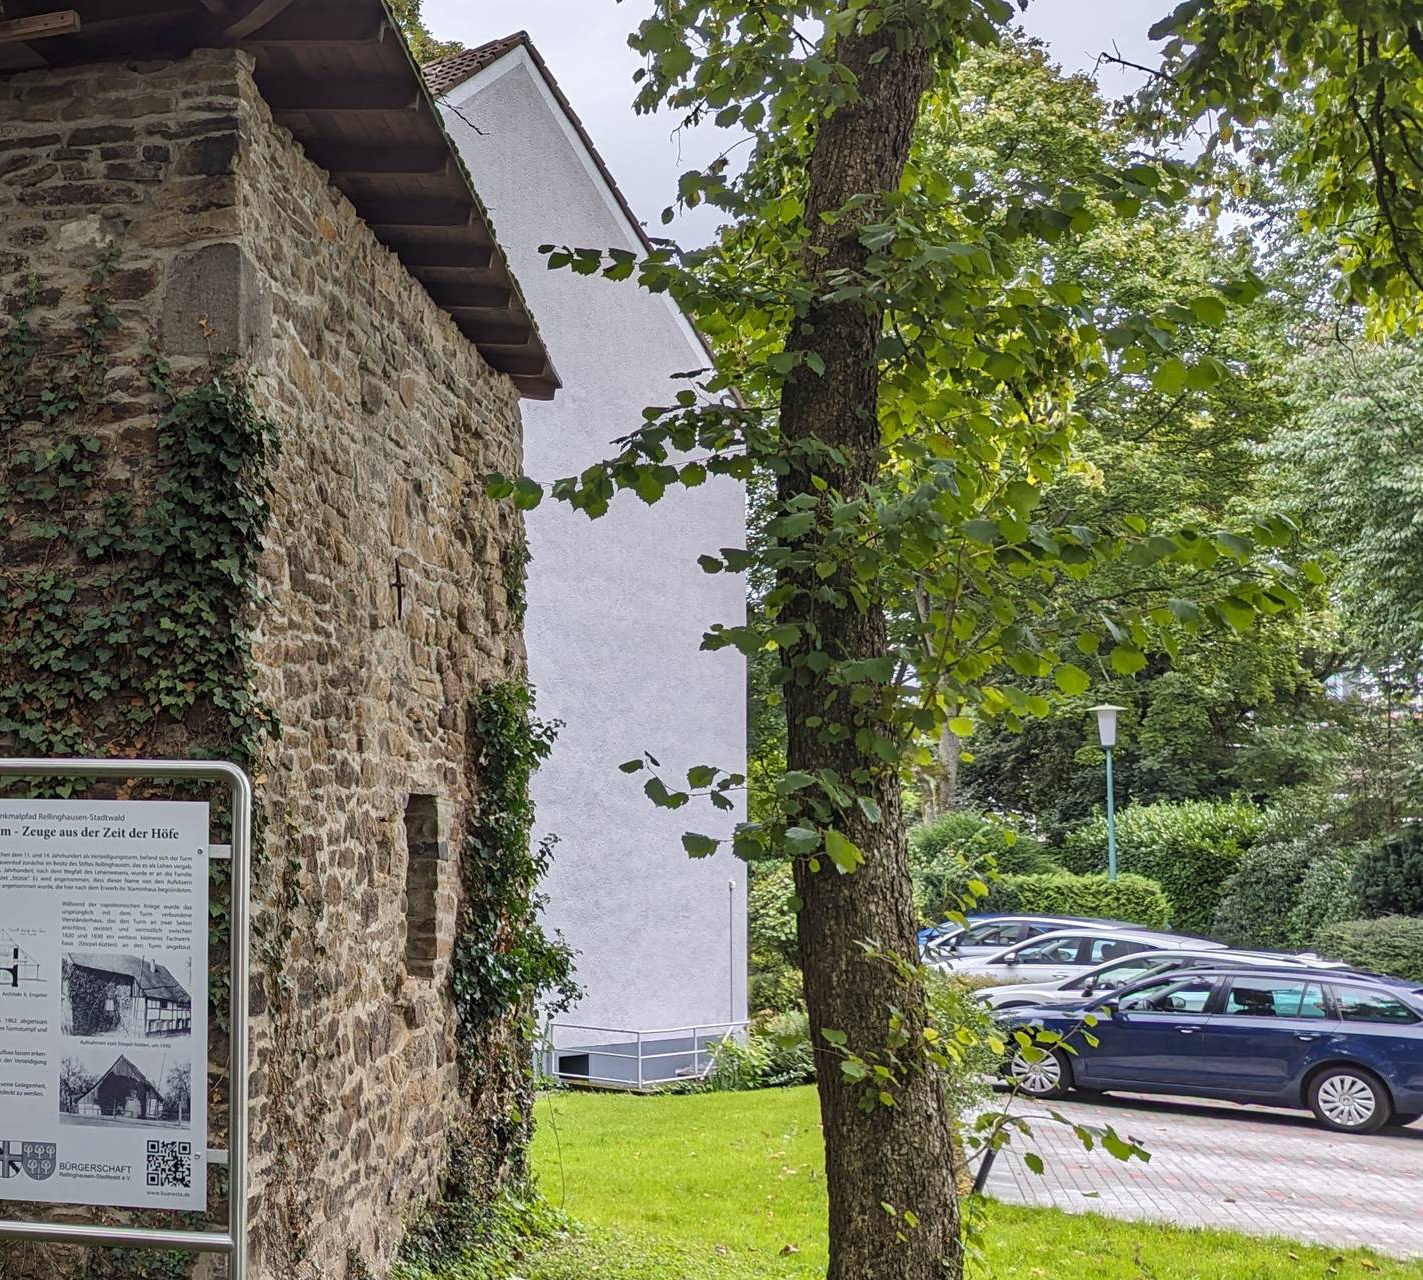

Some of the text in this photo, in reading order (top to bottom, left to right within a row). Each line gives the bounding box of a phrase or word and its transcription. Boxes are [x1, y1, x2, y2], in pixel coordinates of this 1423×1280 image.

[38, 813, 126, 822] Rellinghausen-Stadtwald
[22, 825, 57, 840] Zeuge
[59, 828, 78, 838] aus
[80, 827, 100, 838] der
[102, 827, 126, 838] Zeit
[128, 827, 148, 839] der
[151, 827, 180, 839] Höfe
[59, 1161, 132, 1174] BÜRGERSCHAFT
